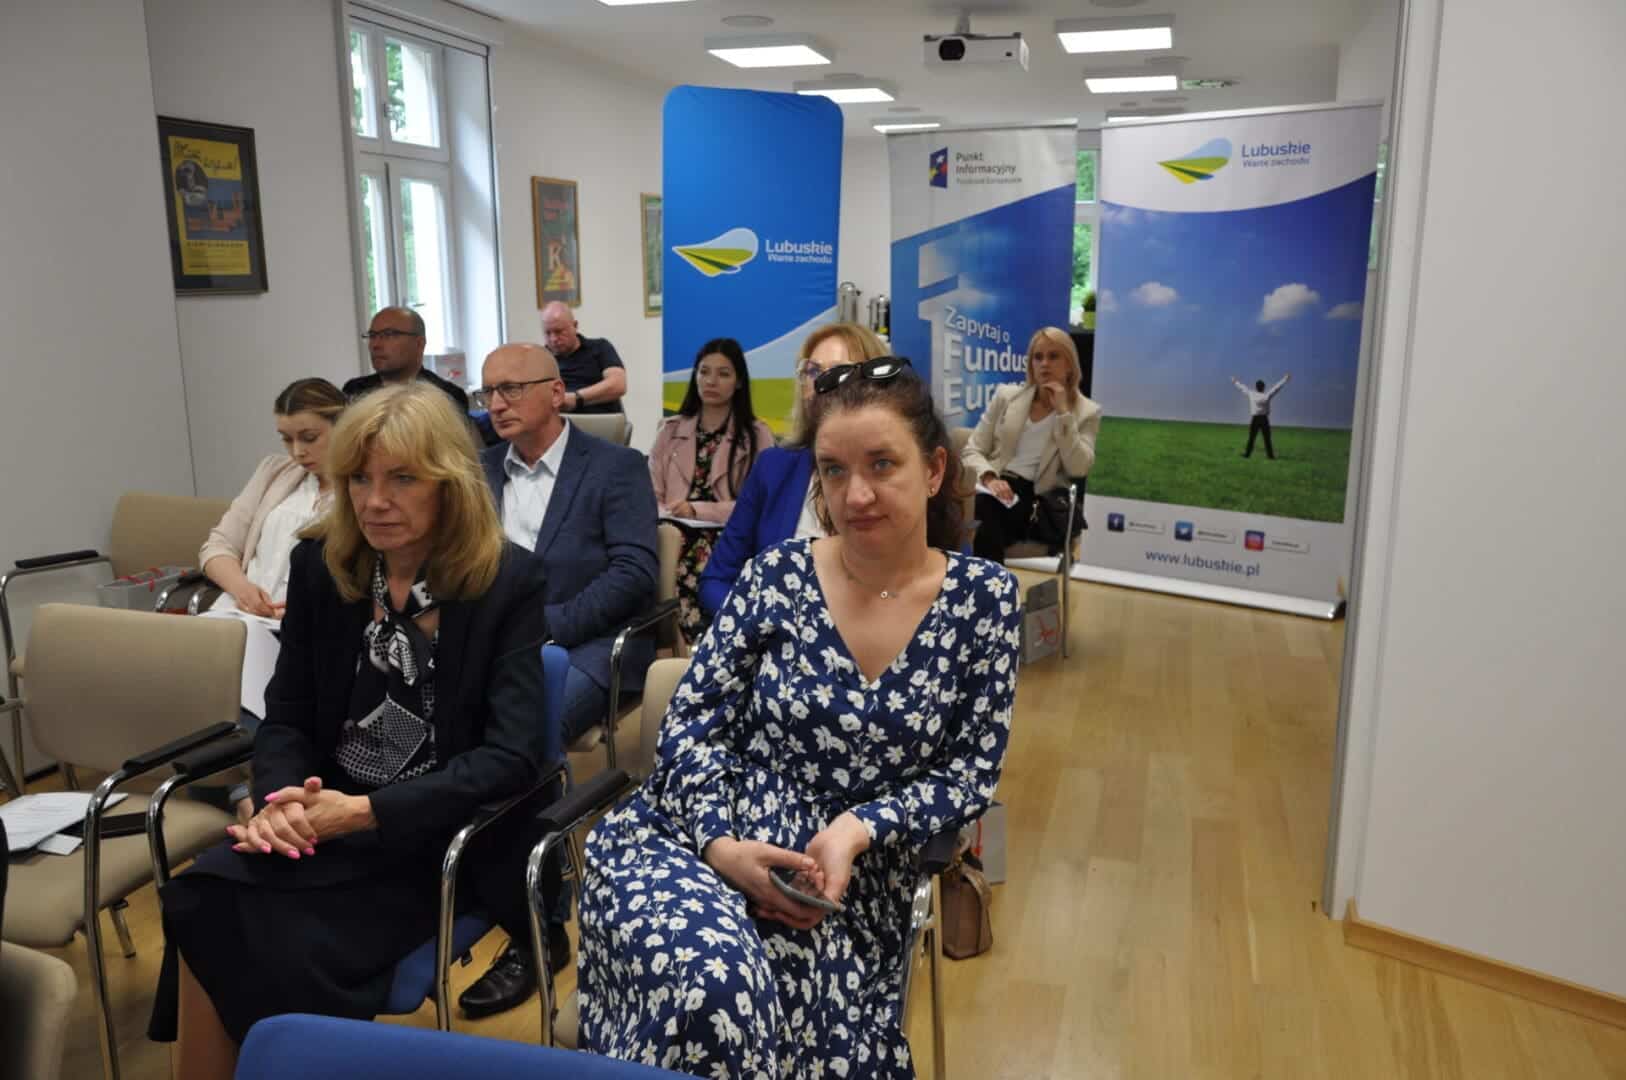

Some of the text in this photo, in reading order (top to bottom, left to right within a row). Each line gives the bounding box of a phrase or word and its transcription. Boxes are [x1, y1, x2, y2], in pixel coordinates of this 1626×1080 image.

[956, 152, 983, 161] Punkt
[1241, 140, 1311, 158] Lubuskie
[956, 164, 1017, 175] Informacyjny
[766, 240, 833, 255] Lubuskie
[944, 305, 1011, 344] Zapytaj o
[943, 332, 1029, 374] Fundus
[1145, 551, 1261, 577] www.lubuskie.pl
